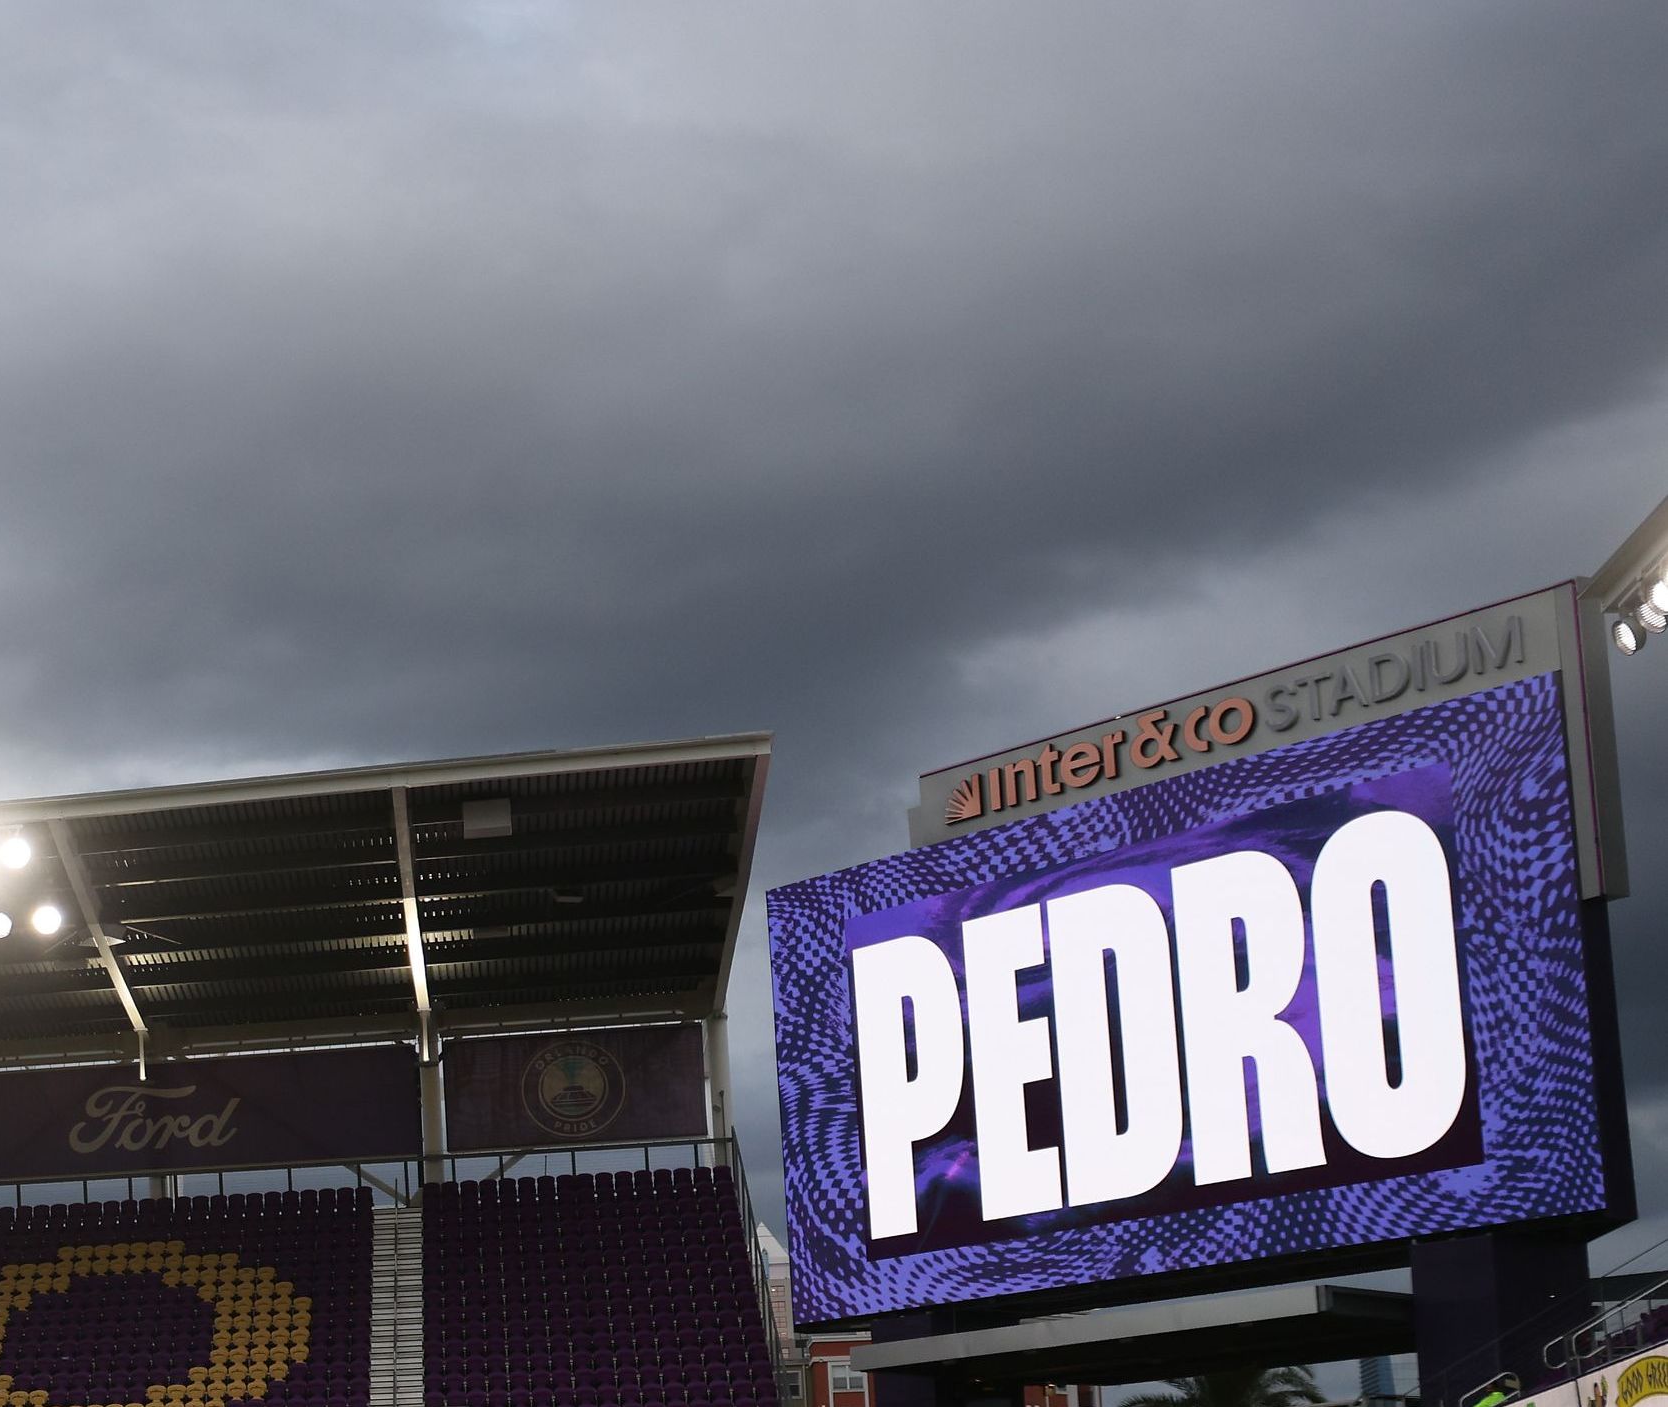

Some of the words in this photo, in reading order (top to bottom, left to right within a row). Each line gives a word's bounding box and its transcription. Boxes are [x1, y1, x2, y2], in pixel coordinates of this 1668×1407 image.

[987, 697, 1256, 814] inter&co
[1265, 614, 1527, 733] STADIUM
[852, 811, 1465, 1239] PEDRO
[69, 1084, 241, 1154] Ford
[553, 1119, 599, 1132] PRIDE
